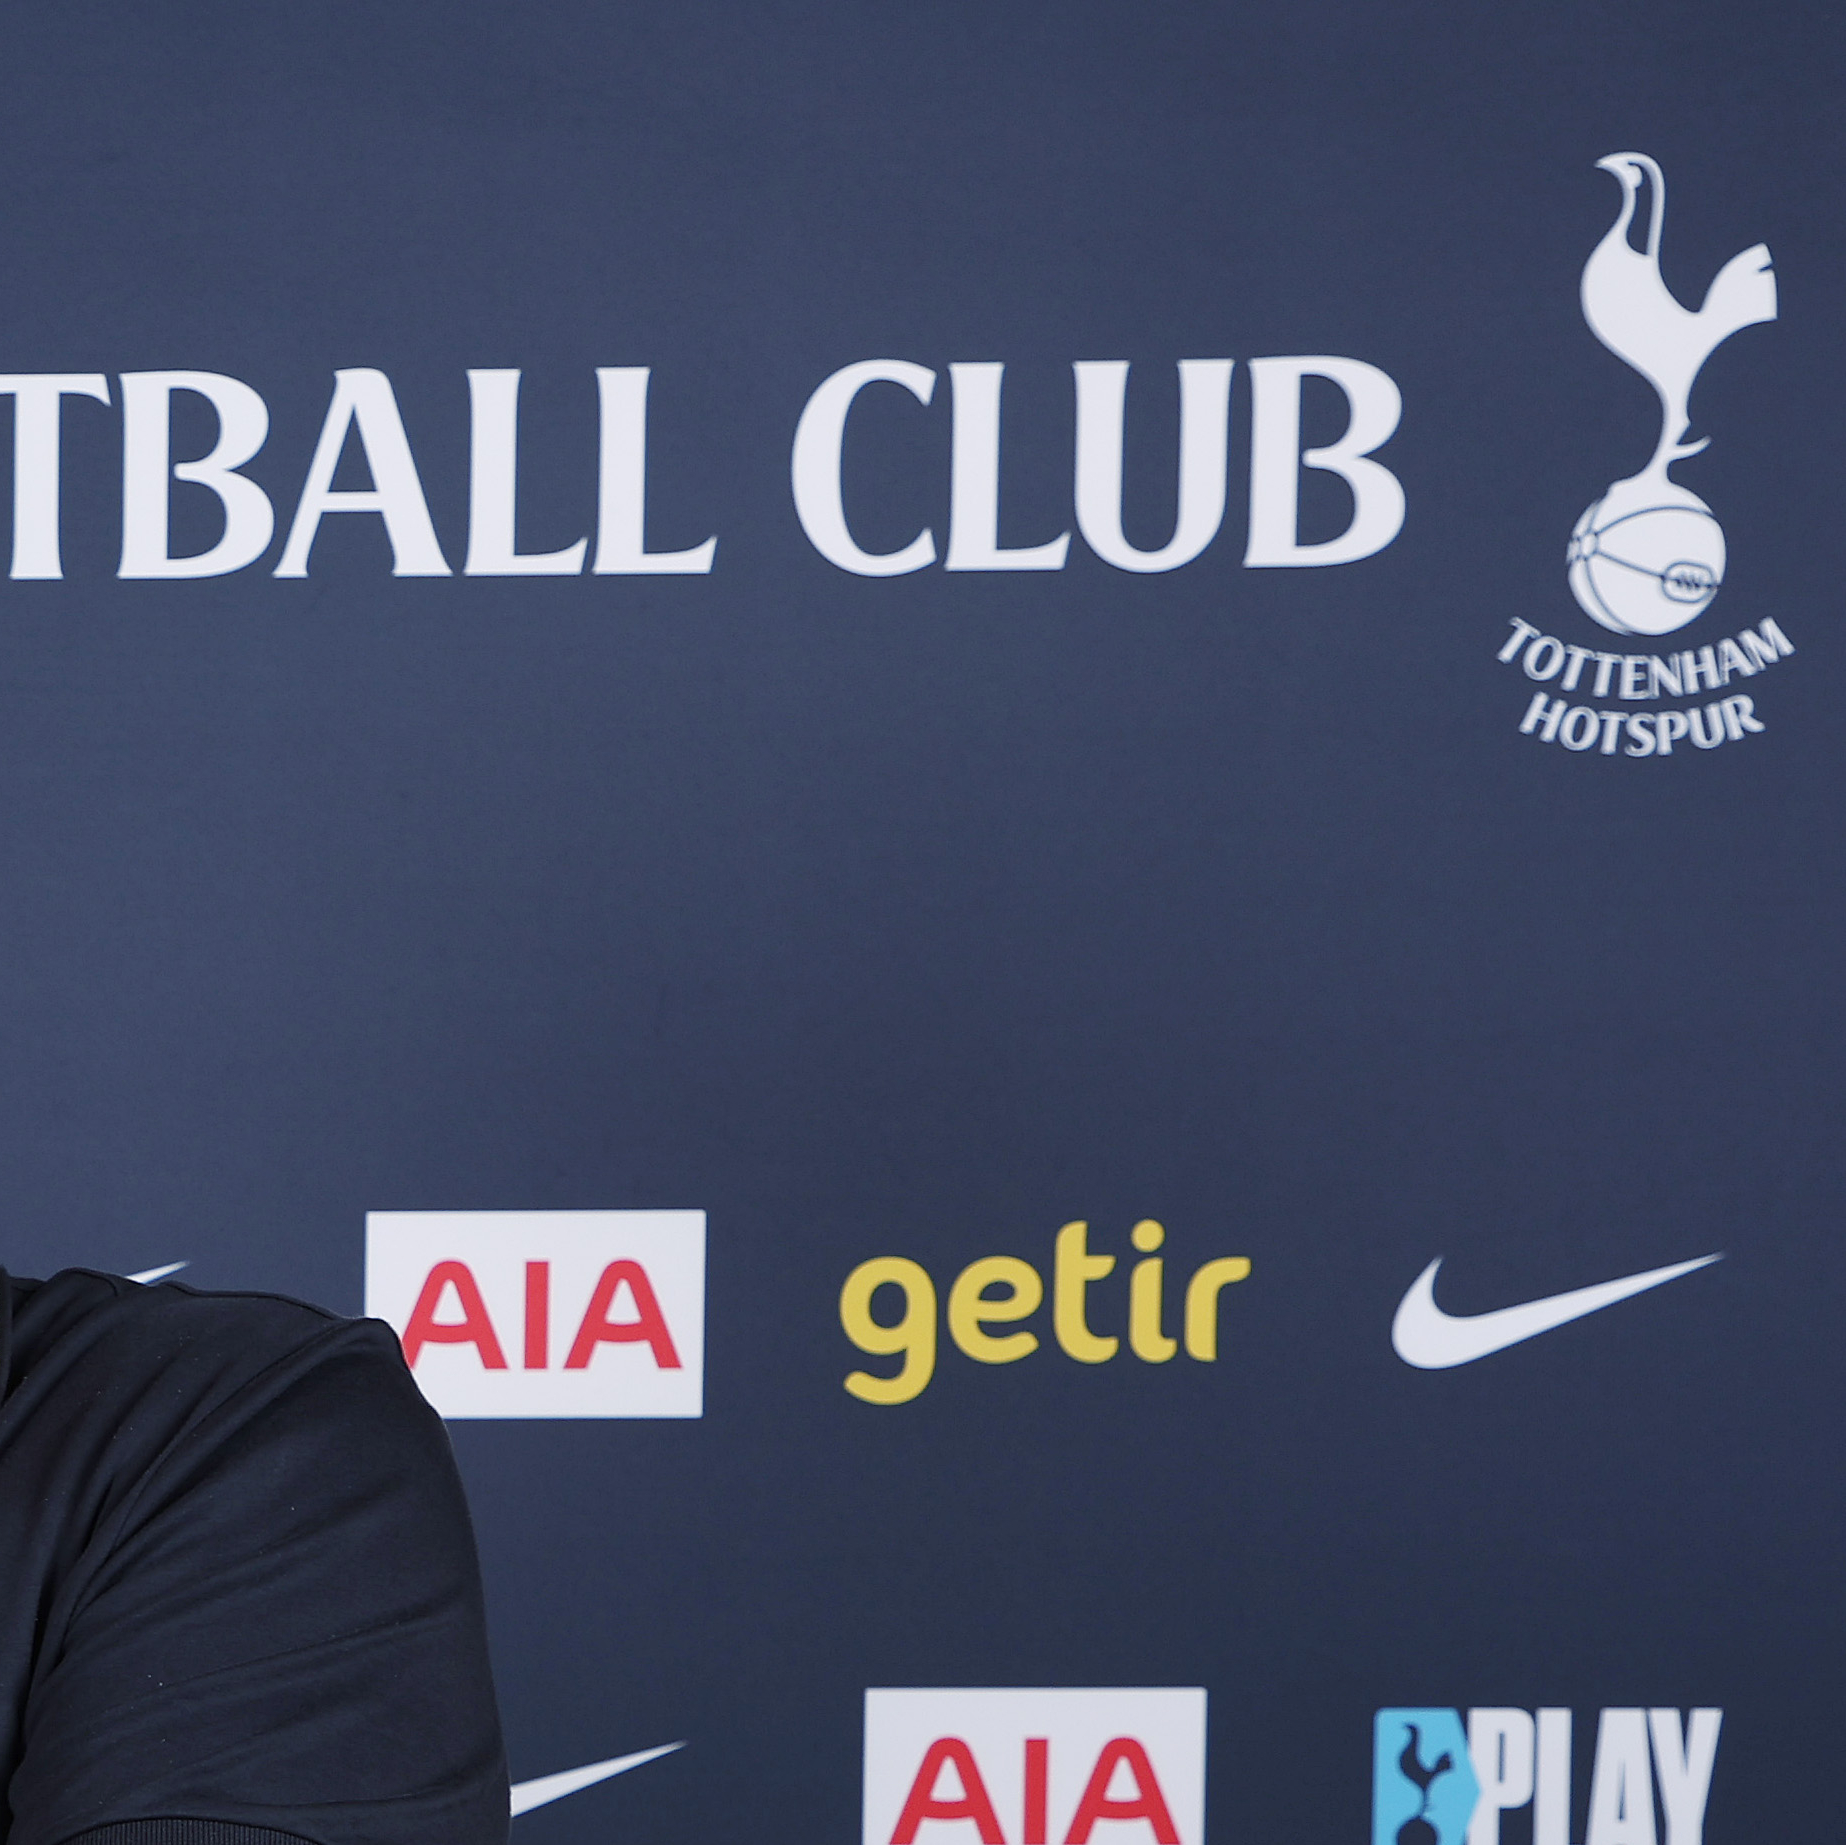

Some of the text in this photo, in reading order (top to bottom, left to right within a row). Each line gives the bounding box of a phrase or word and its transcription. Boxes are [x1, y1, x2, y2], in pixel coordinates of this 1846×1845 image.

[790, 354, 1406, 578] CLUB
[1497, 616, 1796, 701] TOTTENHAM
[1519, 691, 1766, 758] HOTSPUR
[400, 1259, 682, 1370] AIA
[840, 1219, 1252, 1405] getir
